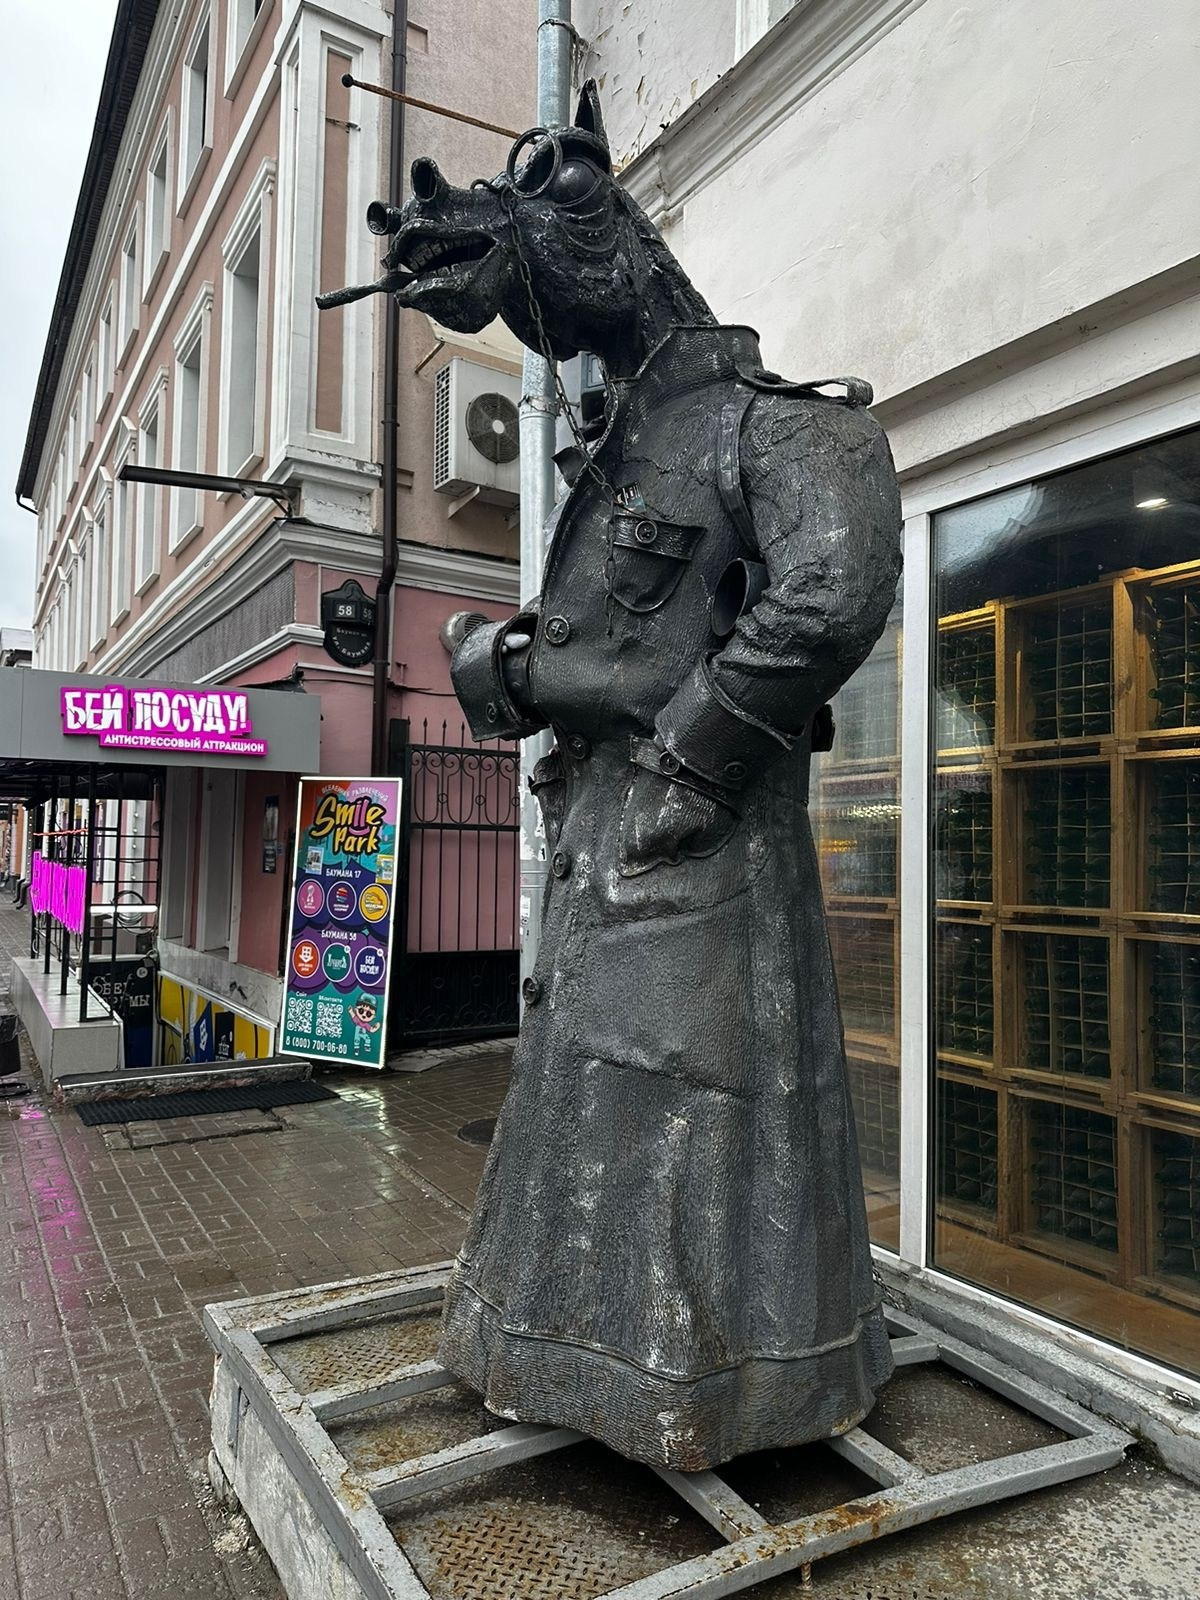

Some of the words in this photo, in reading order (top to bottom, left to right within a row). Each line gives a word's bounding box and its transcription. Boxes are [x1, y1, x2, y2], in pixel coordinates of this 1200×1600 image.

[338, 605, 353, 616] 58
[64, 688, 124, 731] БЕЙ
[133, 691, 248, 734] ПОСУДУ!
[103, 734, 201, 749] АНТИСТРЕССОВЫЙ
[203, 740, 264, 753] АТТРАКЦИОН
[311, 795, 384, 837] Smile
[334, 826, 378, 853] Park
[325, 868, 353, 878] БАУМАНА
[354, 870, 362, 879] 17
[321, 929, 348, 940] БАУМАНА
[285, 1035, 291, 1046] 8
[292, 1036, 311, 1049] (800)
[312, 1039, 348, 1055] 700-06-80
